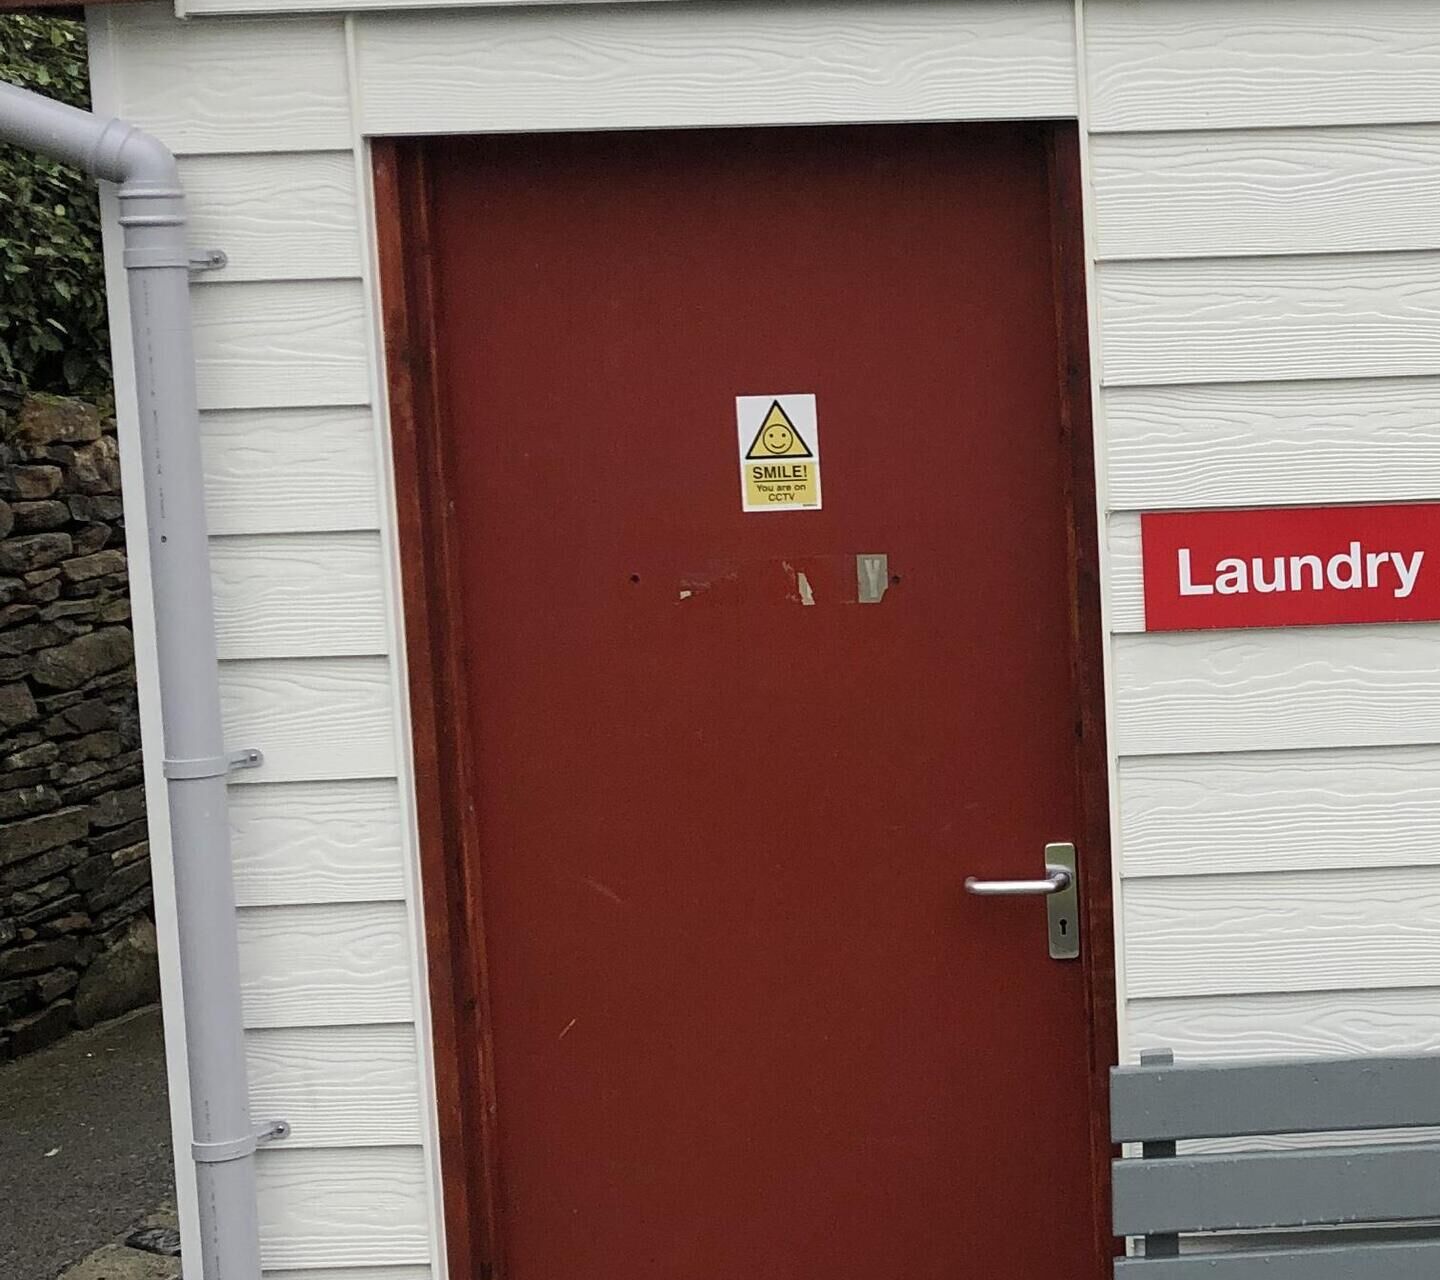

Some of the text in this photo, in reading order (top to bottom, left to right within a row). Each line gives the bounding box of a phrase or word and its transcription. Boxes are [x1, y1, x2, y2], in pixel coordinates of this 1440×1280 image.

[752, 465, 808, 480] SMILE!
[756, 484, 774, 493] You
[768, 492, 796, 503] CCTV
[1177, 542, 1425, 598] Laundry
